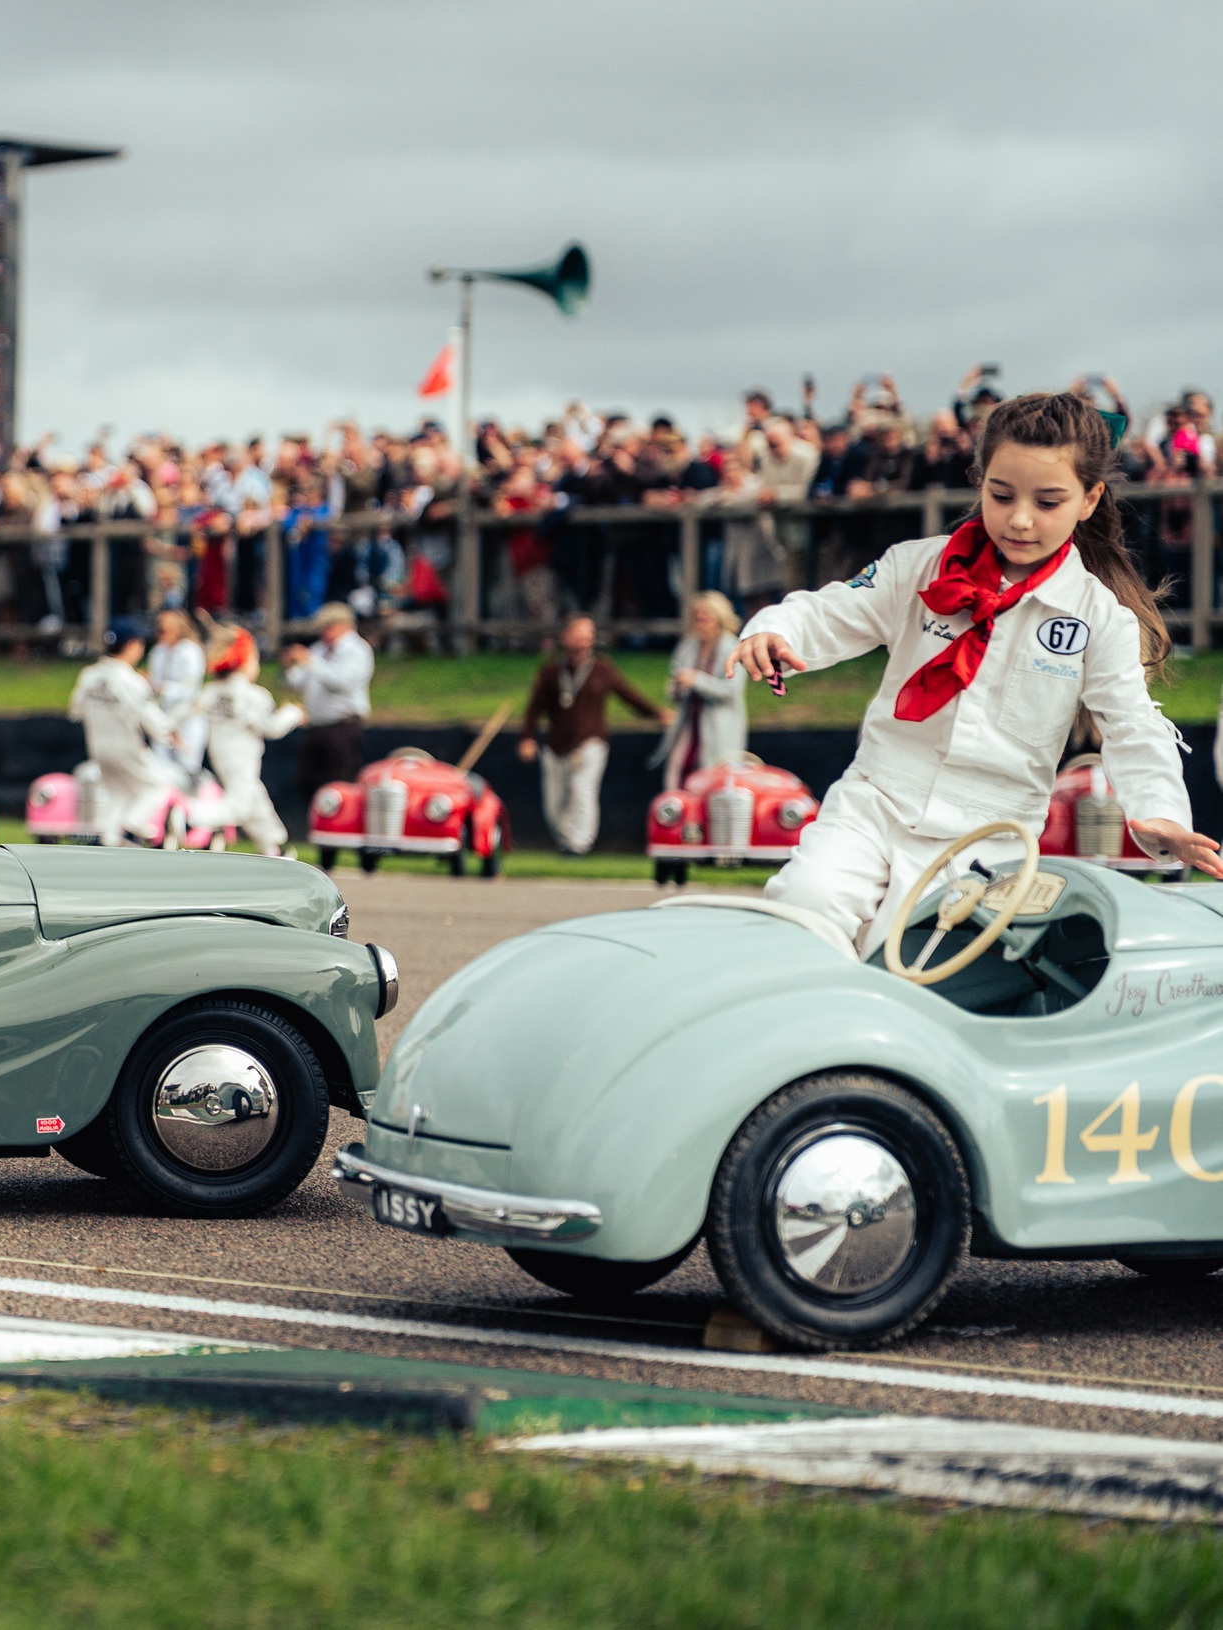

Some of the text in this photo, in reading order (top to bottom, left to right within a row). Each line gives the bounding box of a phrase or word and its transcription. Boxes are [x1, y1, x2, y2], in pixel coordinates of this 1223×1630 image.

[1049, 620, 1080, 651] 67
[1032, 1074, 1223, 1185] 140
[380, 1189, 437, 1229] ISSY
